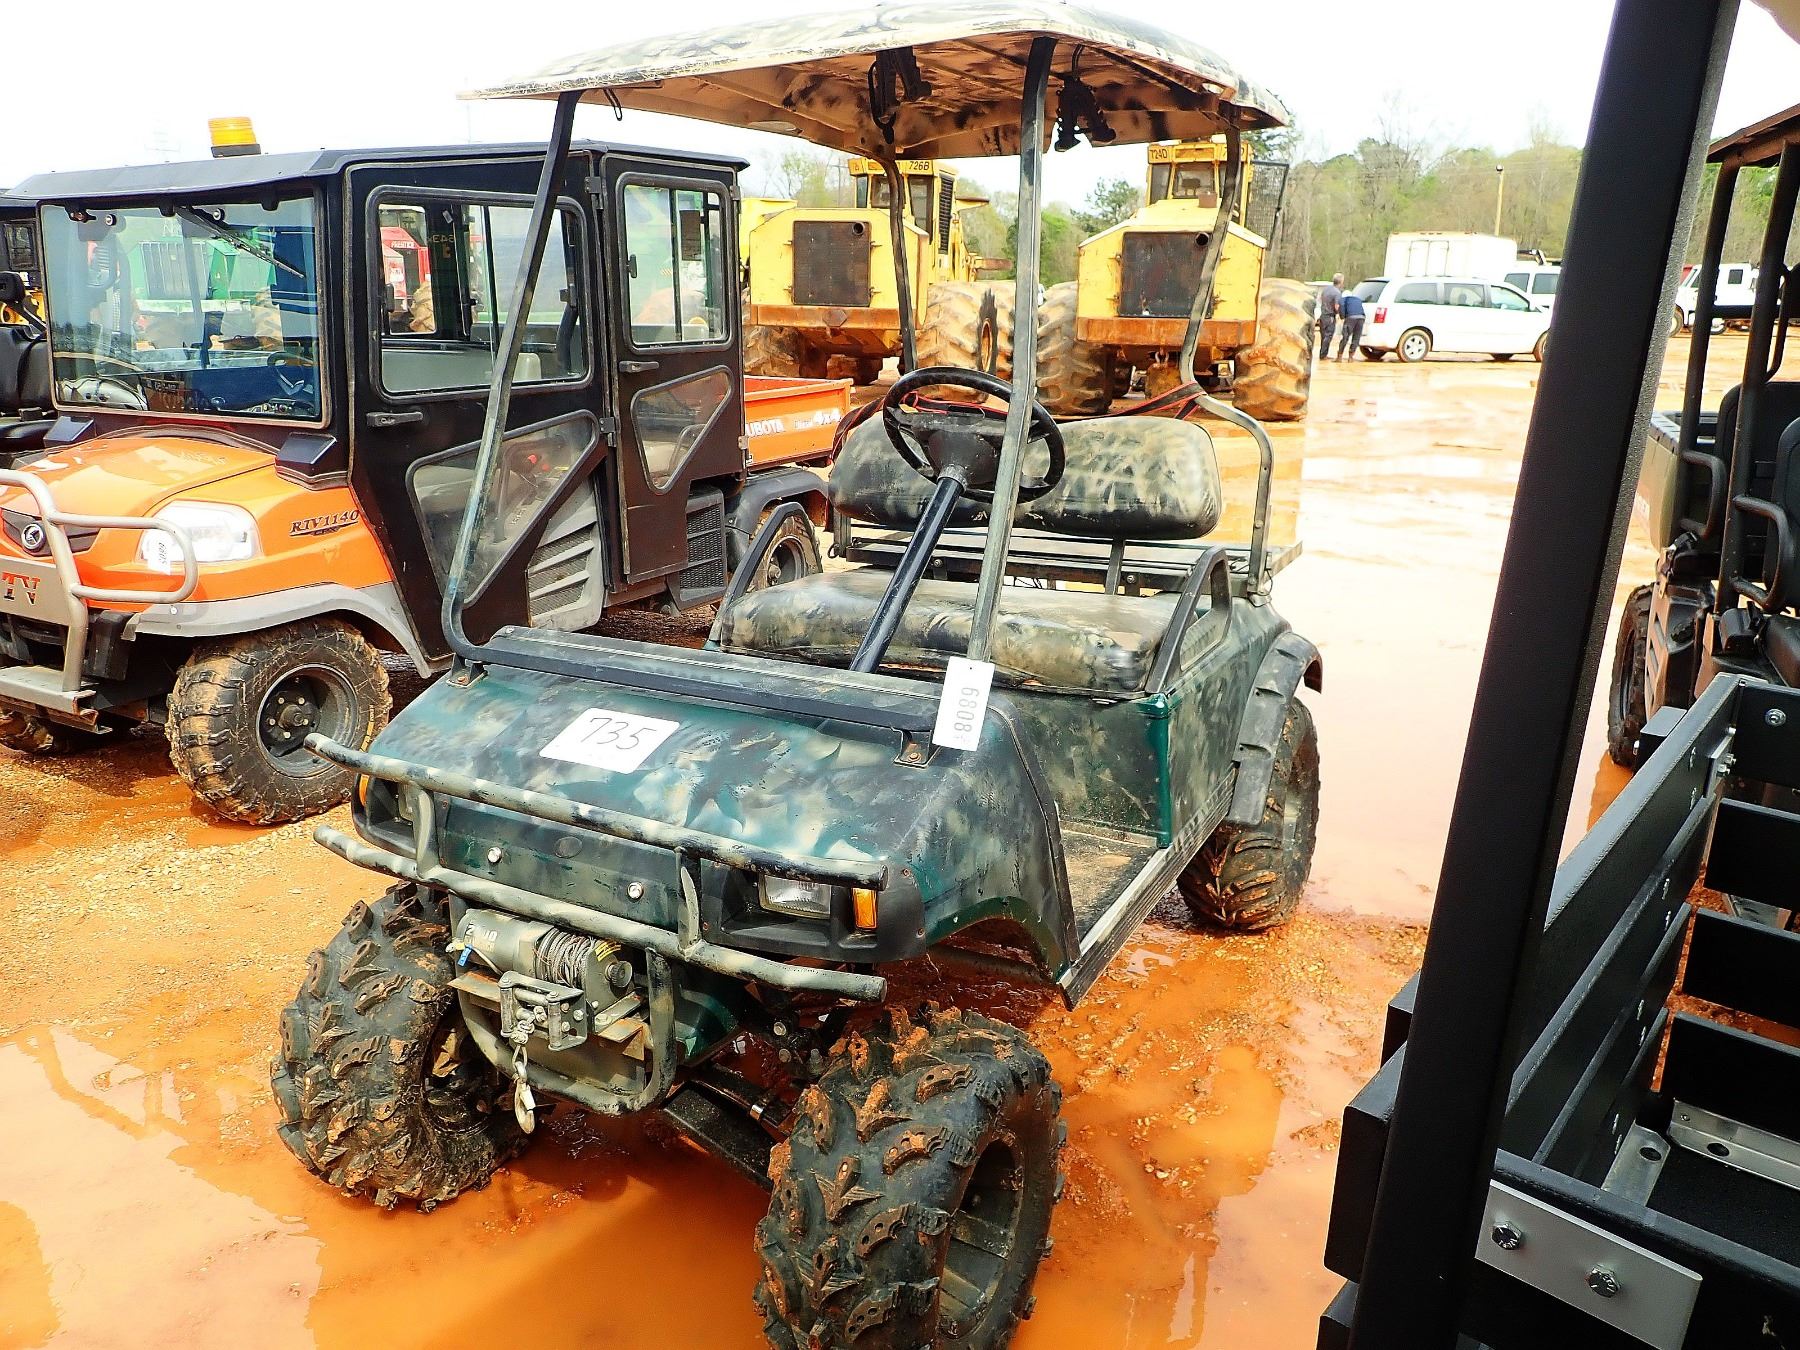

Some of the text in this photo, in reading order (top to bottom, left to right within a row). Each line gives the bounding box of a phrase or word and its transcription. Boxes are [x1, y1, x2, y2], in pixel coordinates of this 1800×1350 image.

[908, 160, 930, 171] 726B
[745, 418, 785, 437] UBOTA
[289, 509, 360, 533] RTV1140
[580, 717, 657, 750] 735
